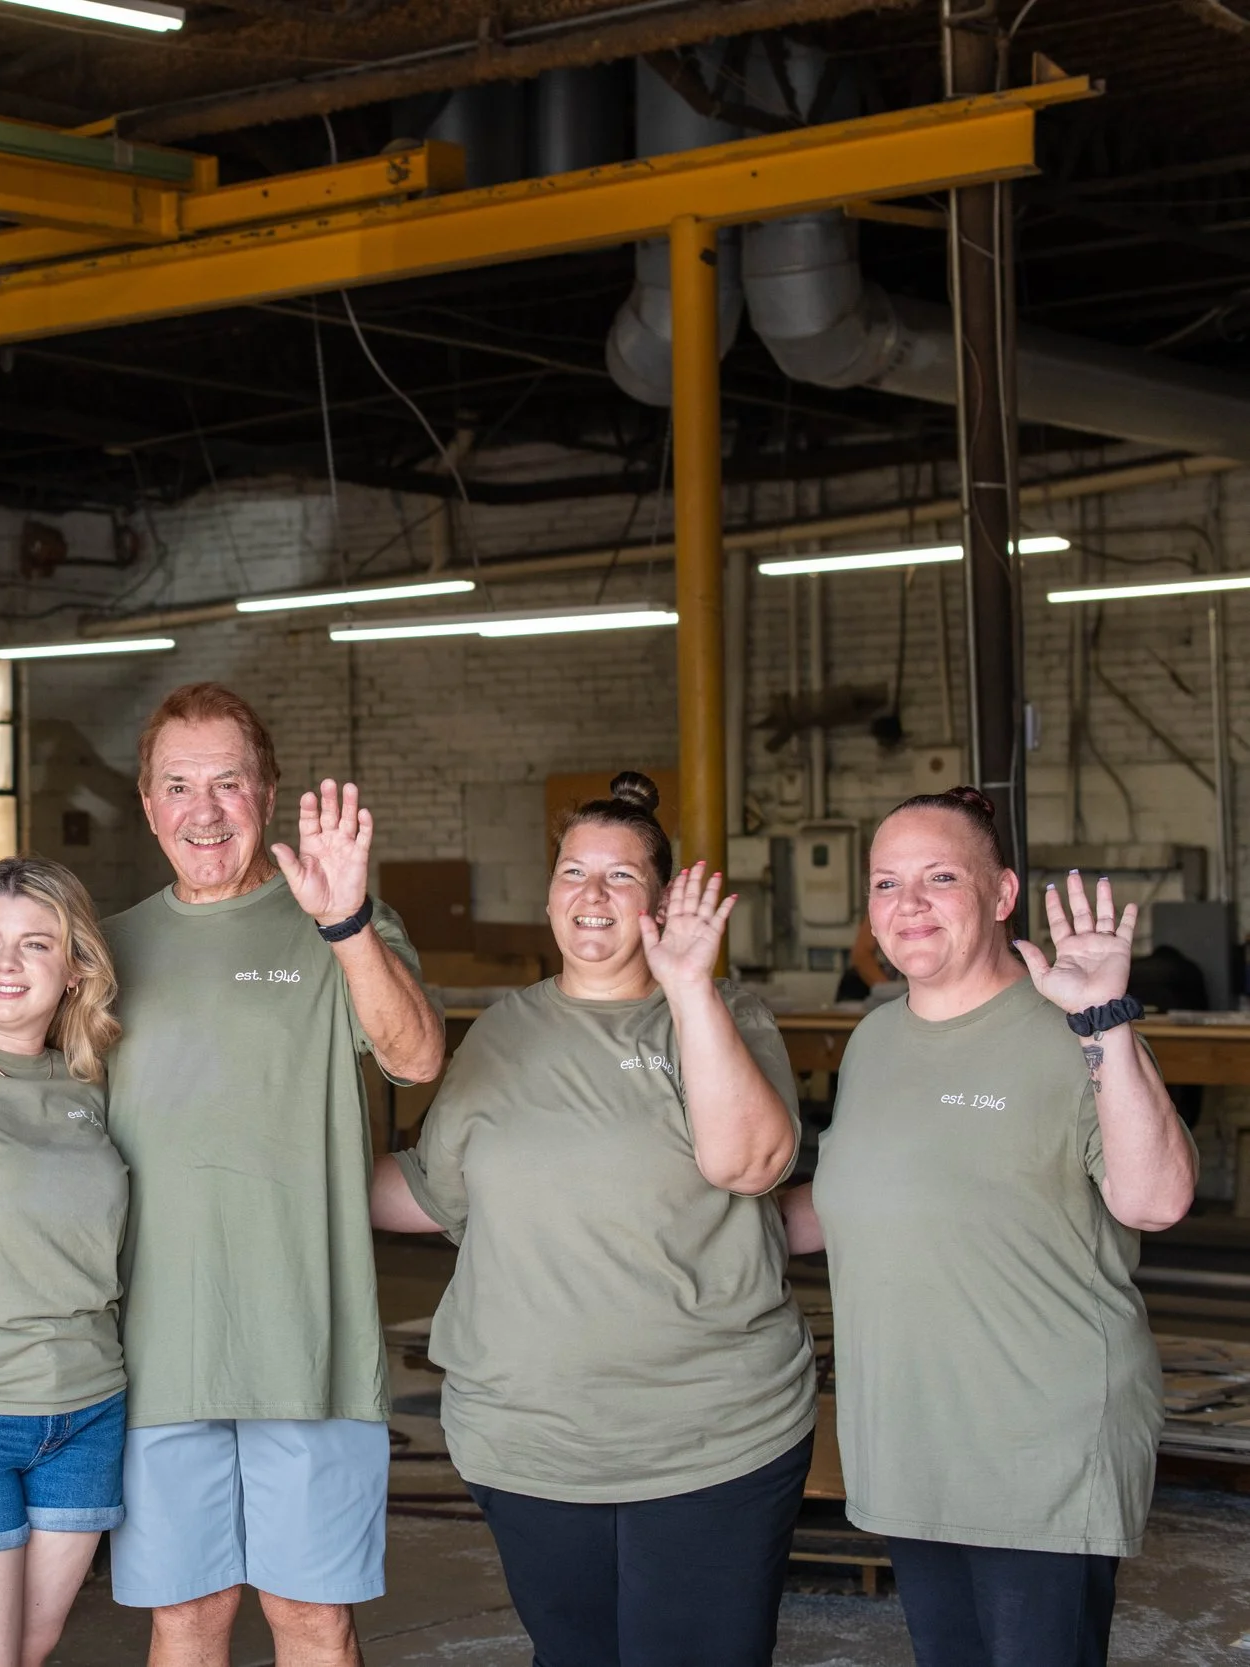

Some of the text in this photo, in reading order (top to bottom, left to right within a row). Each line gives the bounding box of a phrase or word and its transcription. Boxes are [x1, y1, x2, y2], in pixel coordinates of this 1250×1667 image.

[235, 969, 301, 983] est. 1946
[620, 1055, 645, 1070] est.
[940, 1092, 1007, 1111] est. 1946
